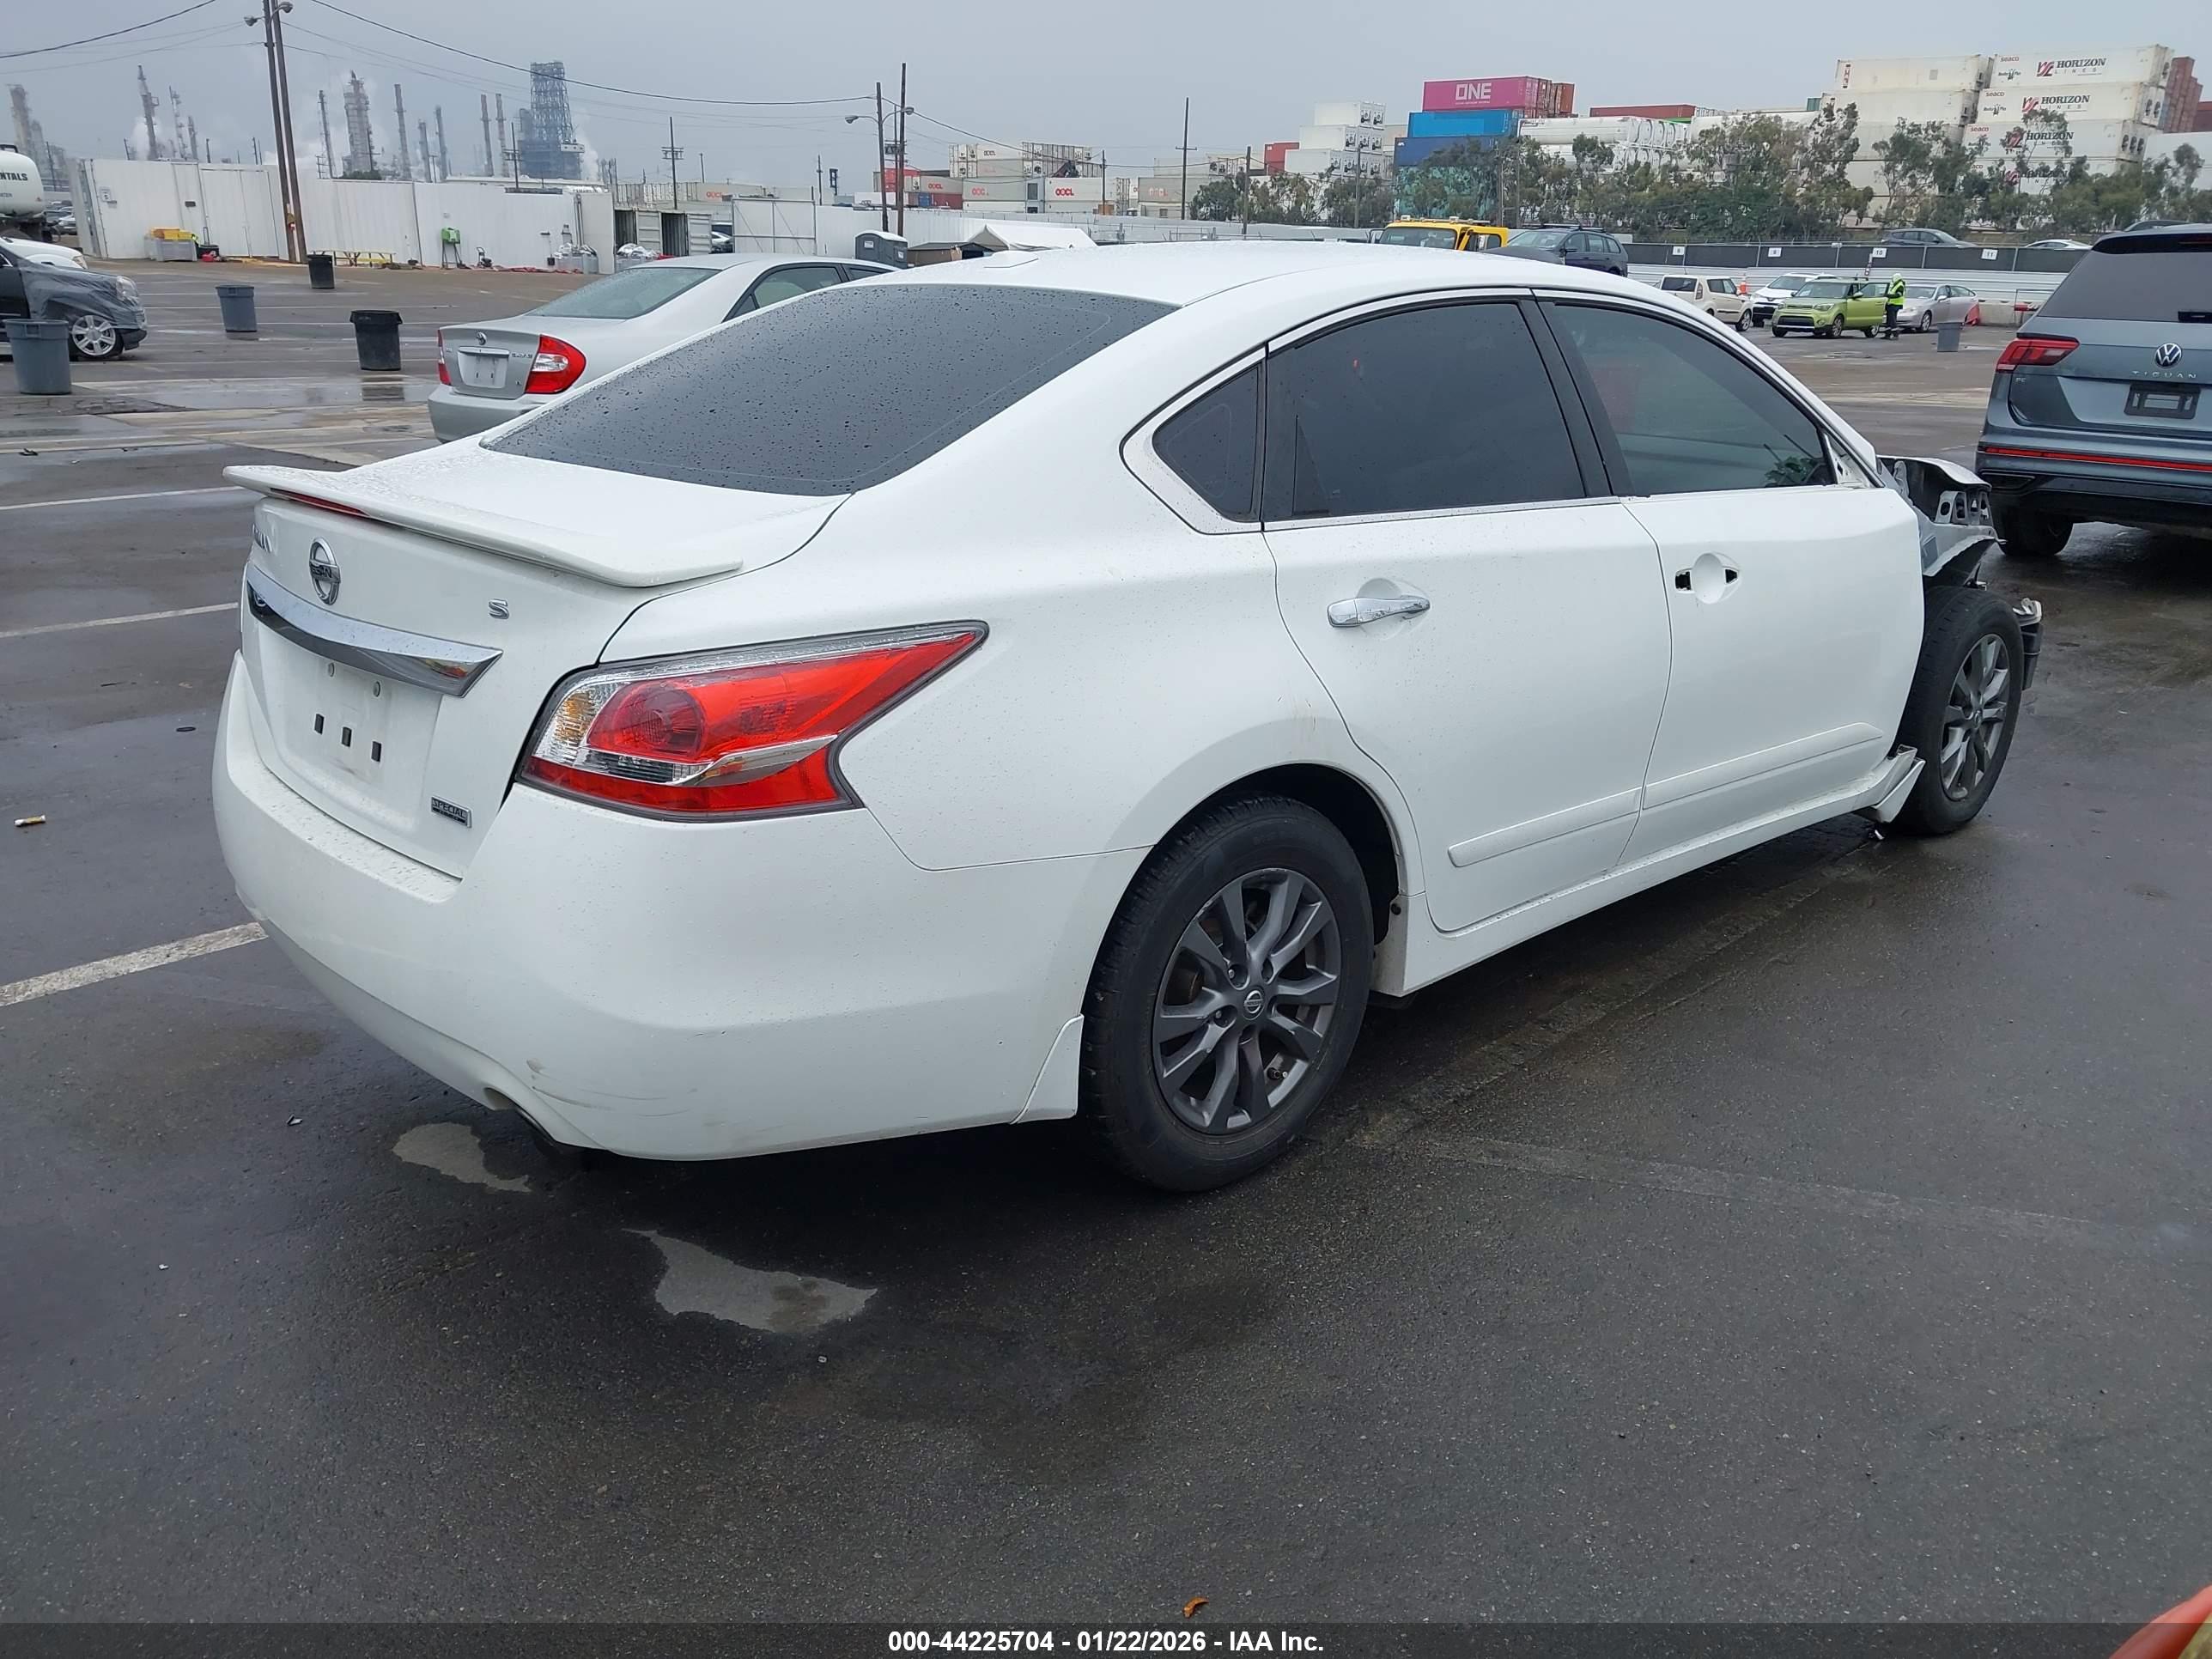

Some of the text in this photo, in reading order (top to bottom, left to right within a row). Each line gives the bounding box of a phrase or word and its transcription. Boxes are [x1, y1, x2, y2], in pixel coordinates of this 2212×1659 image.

[2056, 58, 2107, 69] HORIZON
[1455, 82, 1492, 100] ONE
[2040, 94, 2090, 105] HORIZON
[2026, 131, 2075, 141] HORIZON
[1055, 188, 1074, 197] OOCL
[2130, 370, 2197, 379] TIGUAN
[488, 599, 510, 619] S
[432, 799, 467, 817] SPECIAL
